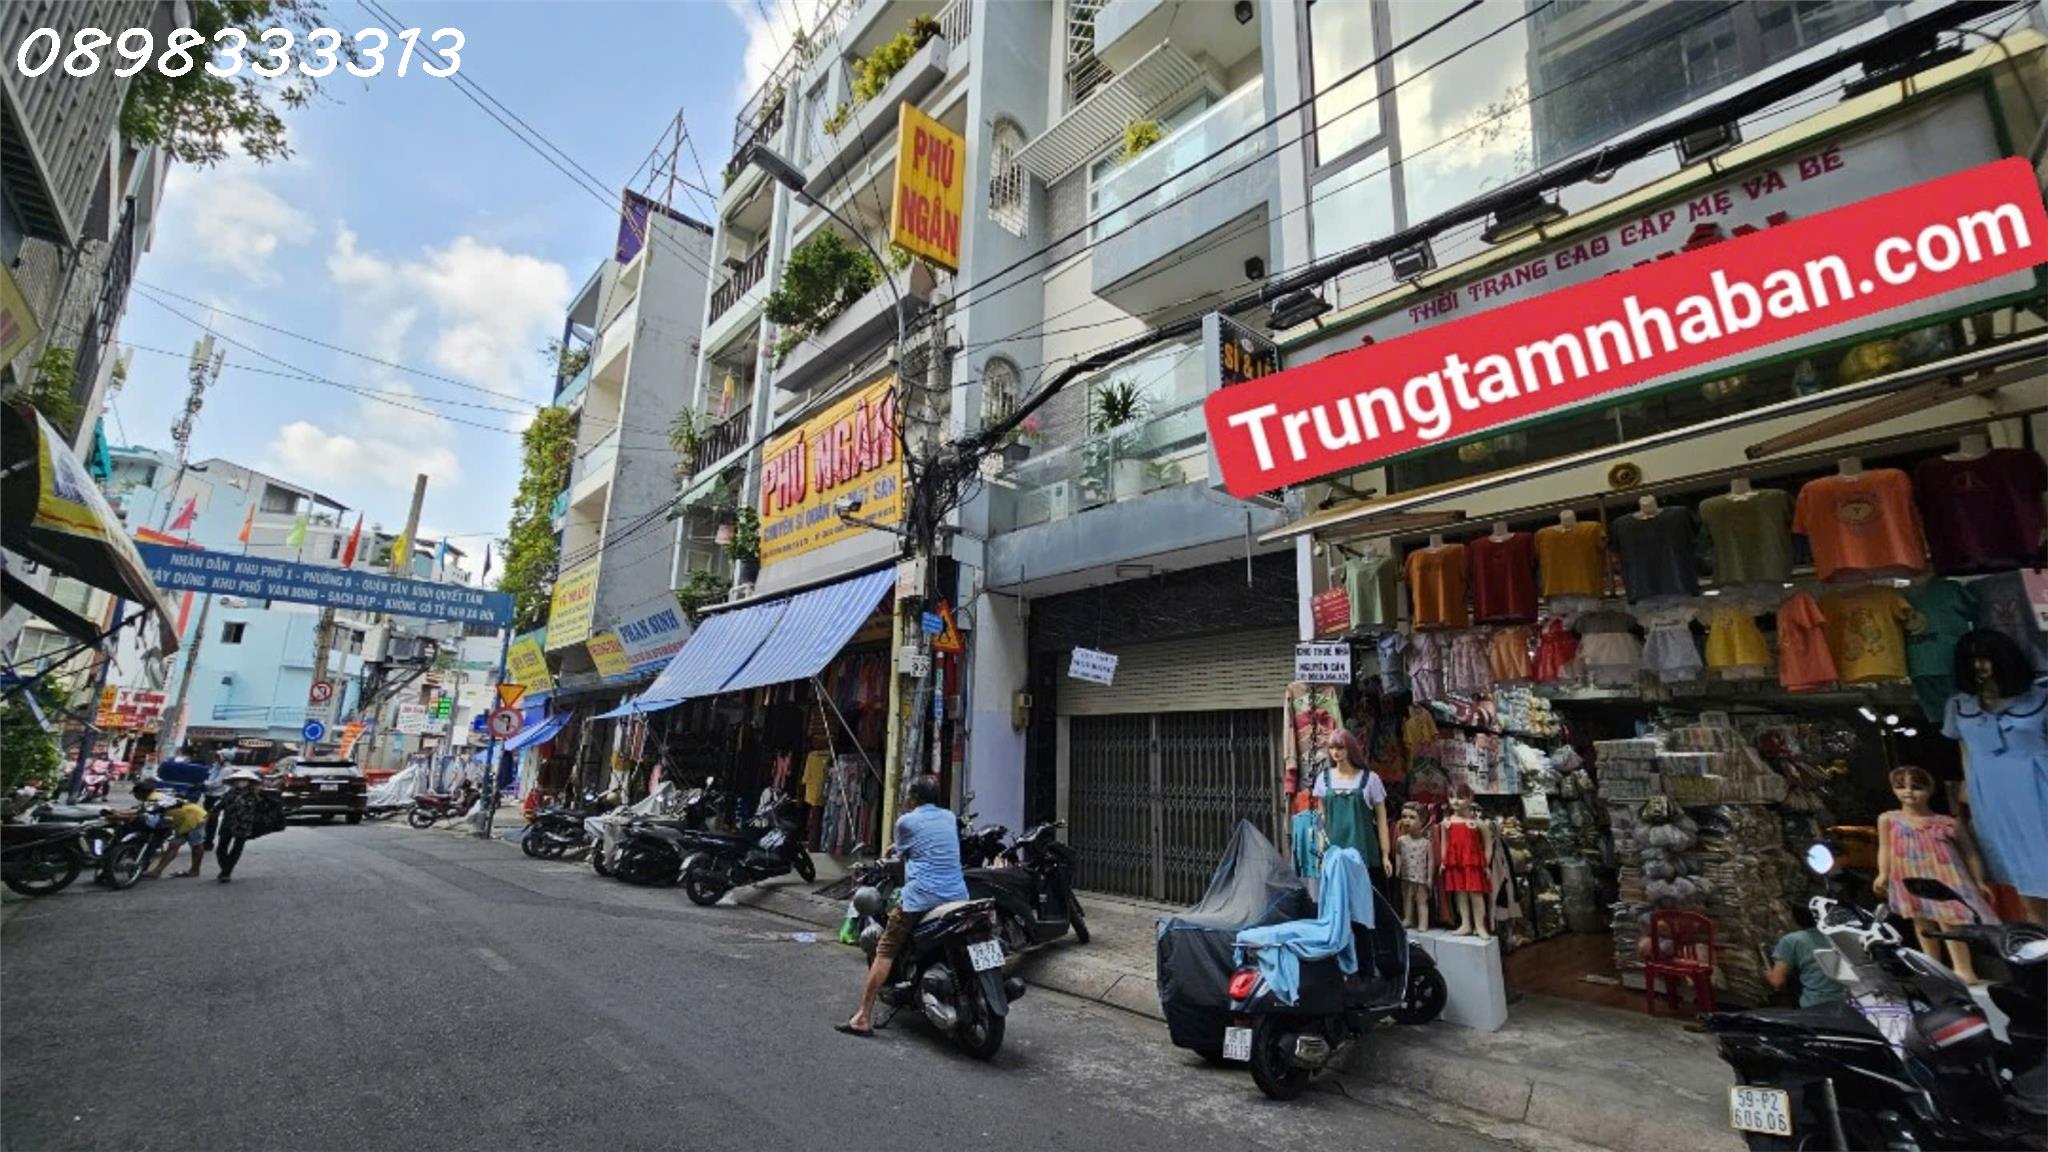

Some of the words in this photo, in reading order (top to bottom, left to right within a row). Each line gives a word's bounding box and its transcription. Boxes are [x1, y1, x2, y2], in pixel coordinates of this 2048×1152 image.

[913, 126, 955, 189] PHÚ
[901, 184, 958, 257] NGÂN
[1409, 290, 1460, 324] THỜI
[1468, 259, 1548, 302] TRANG
[1554, 236, 1610, 271] CAO
[1687, 189, 1734, 222] MẸ
[1742, 164, 1788, 199] VÀ
[1799, 144, 1845, 183] BÉ
[762, 429, 806, 516] PHÚ
[815, 390, 896, 493] NGÂN
[170, 552, 204, 569] NHÂN
[205, 558, 231, 572] DÂN
[234, 562, 257, 574] KHU
[261, 563, 284, 579] PHỐ
[212, 577, 236, 590] KHU
[1734, 1109, 1787, 1132] 606.06
[1738, 1091, 1779, 1111] 59-P2
